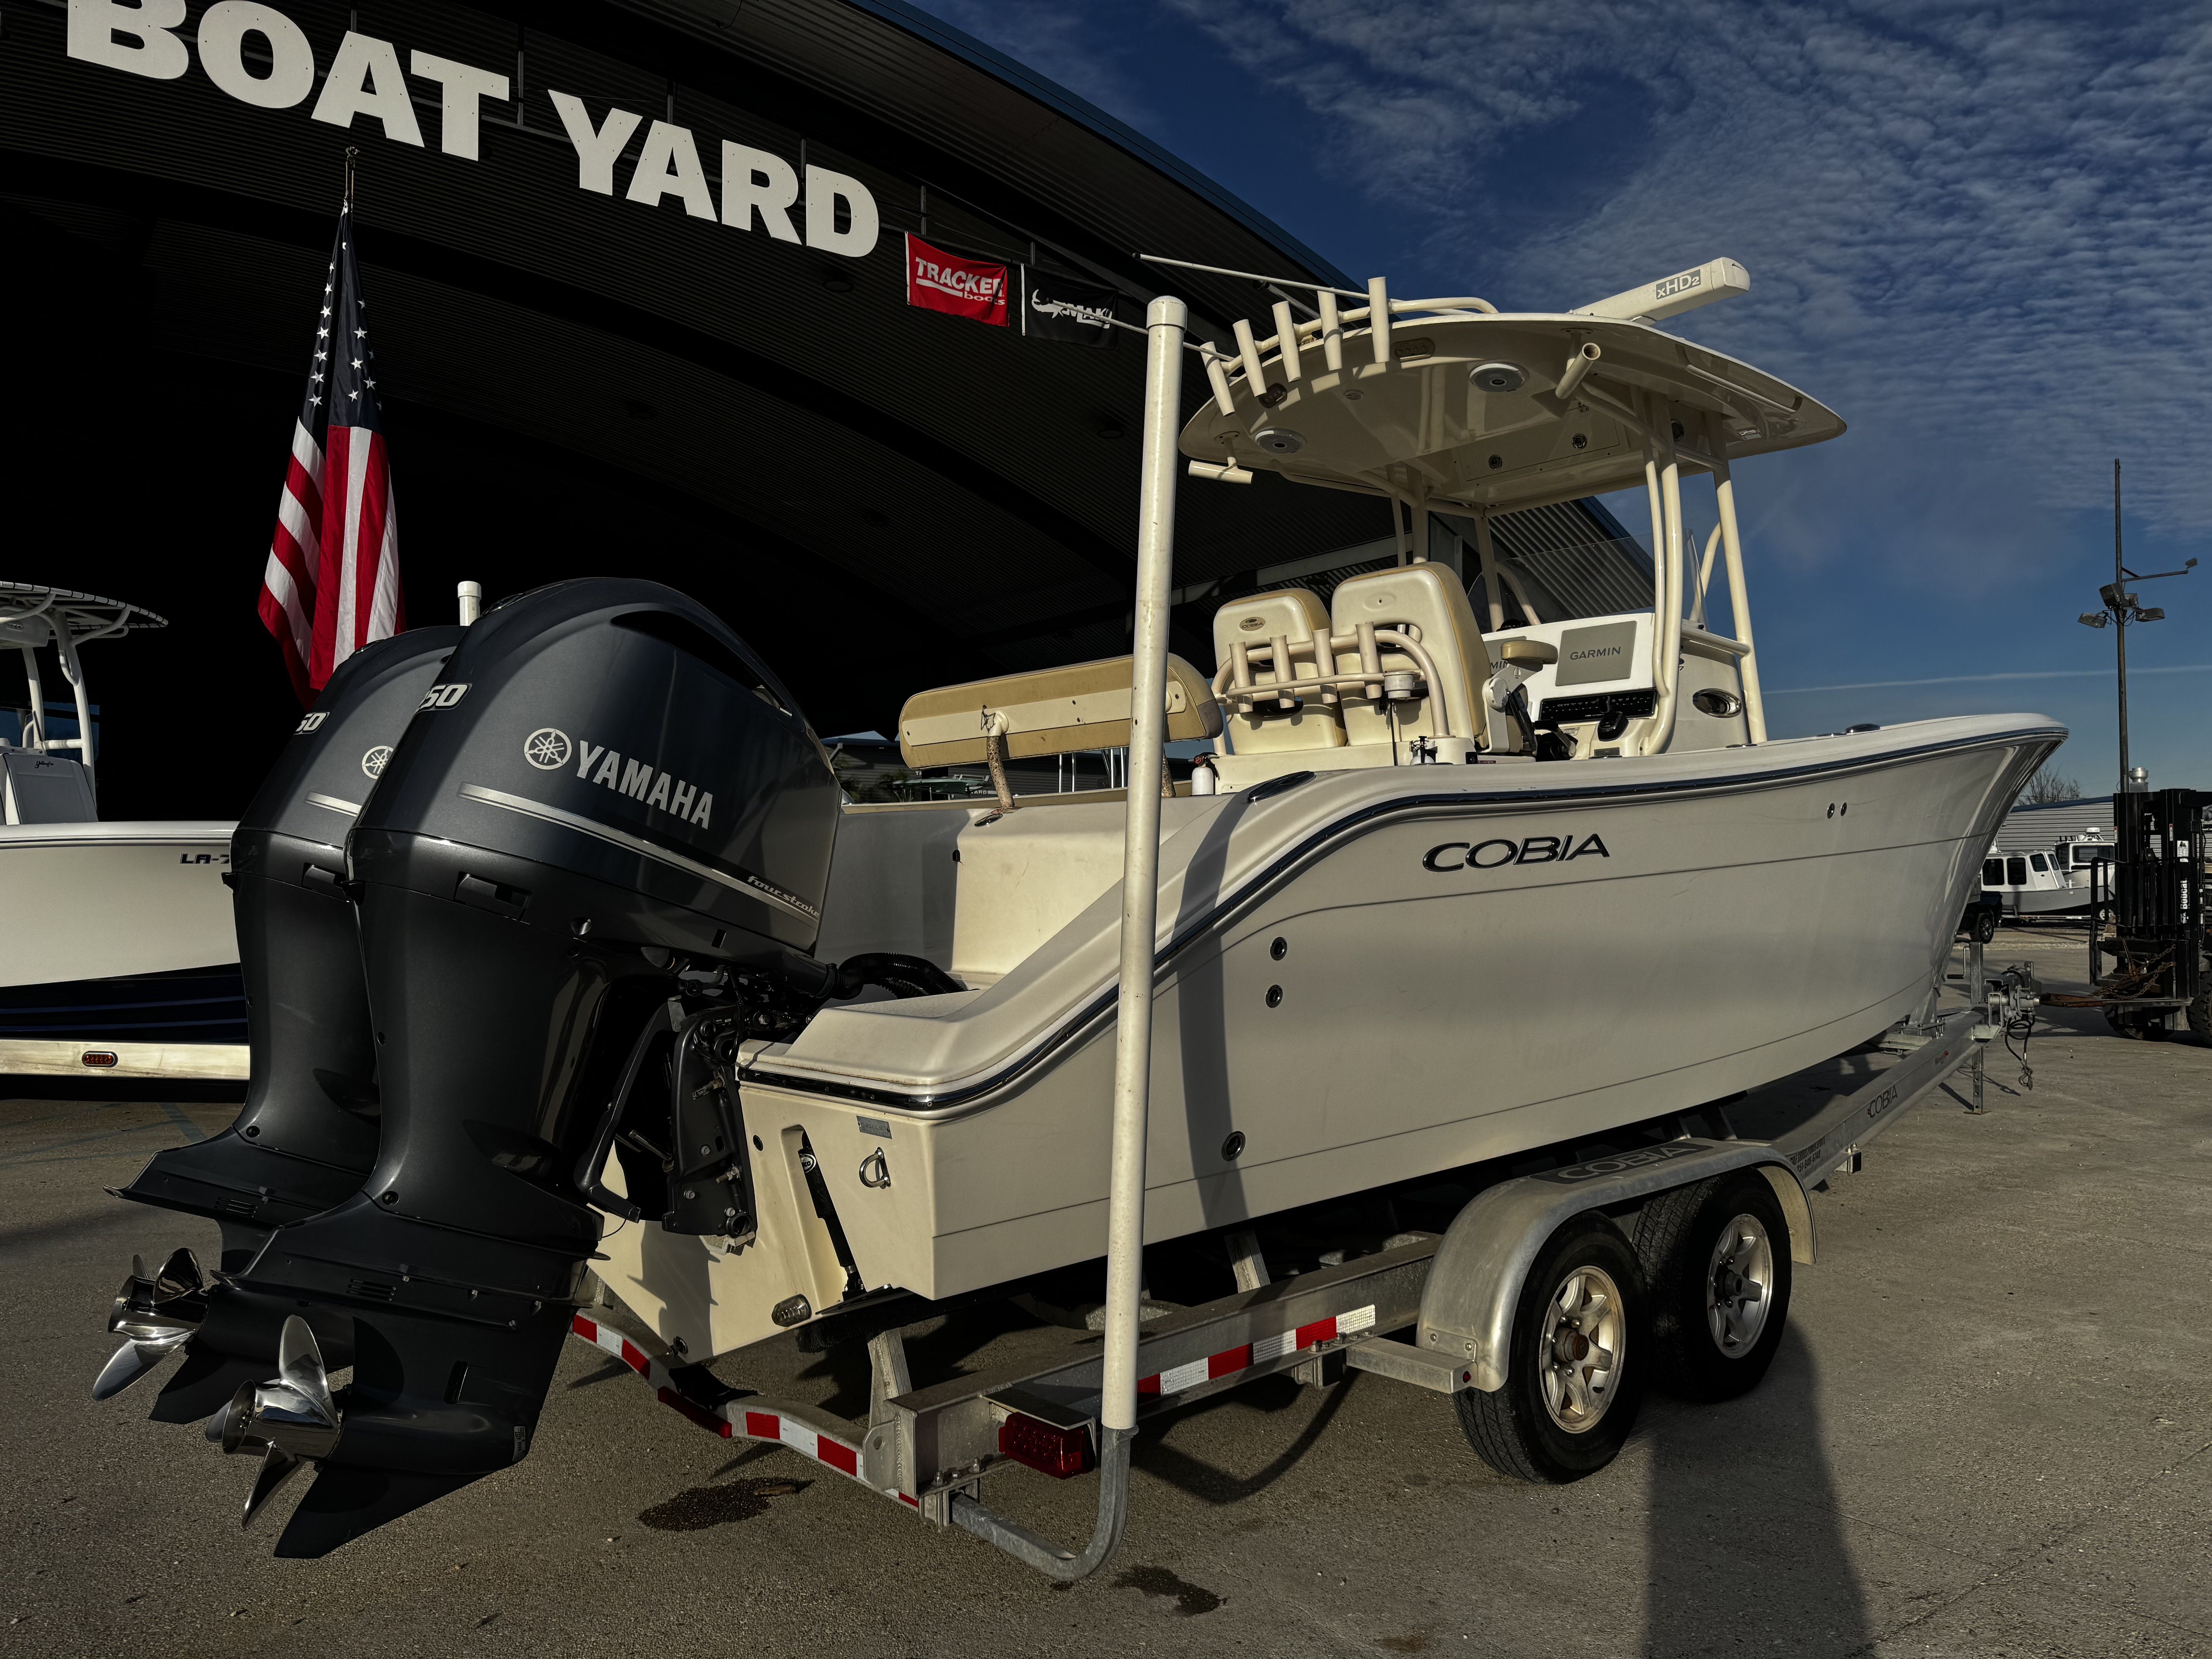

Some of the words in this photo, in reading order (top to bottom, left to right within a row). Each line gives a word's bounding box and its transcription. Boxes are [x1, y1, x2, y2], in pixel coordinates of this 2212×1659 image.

[67, 0, 510, 161] BOAT
[547, 89, 879, 258] YARD
[915, 256, 1005, 297] TRACKER
[1657, 275, 1700, 298] xHD2
[964, 291, 1005, 305] boats
[1570, 646, 1621, 660] GARMIN
[576, 740, 713, 830] YAMAHA
[1422, 833, 1610, 872] COBIA
[1869, 1084, 1898, 1118] COBIA
[1558, 1146, 1698, 1179] COBIA
